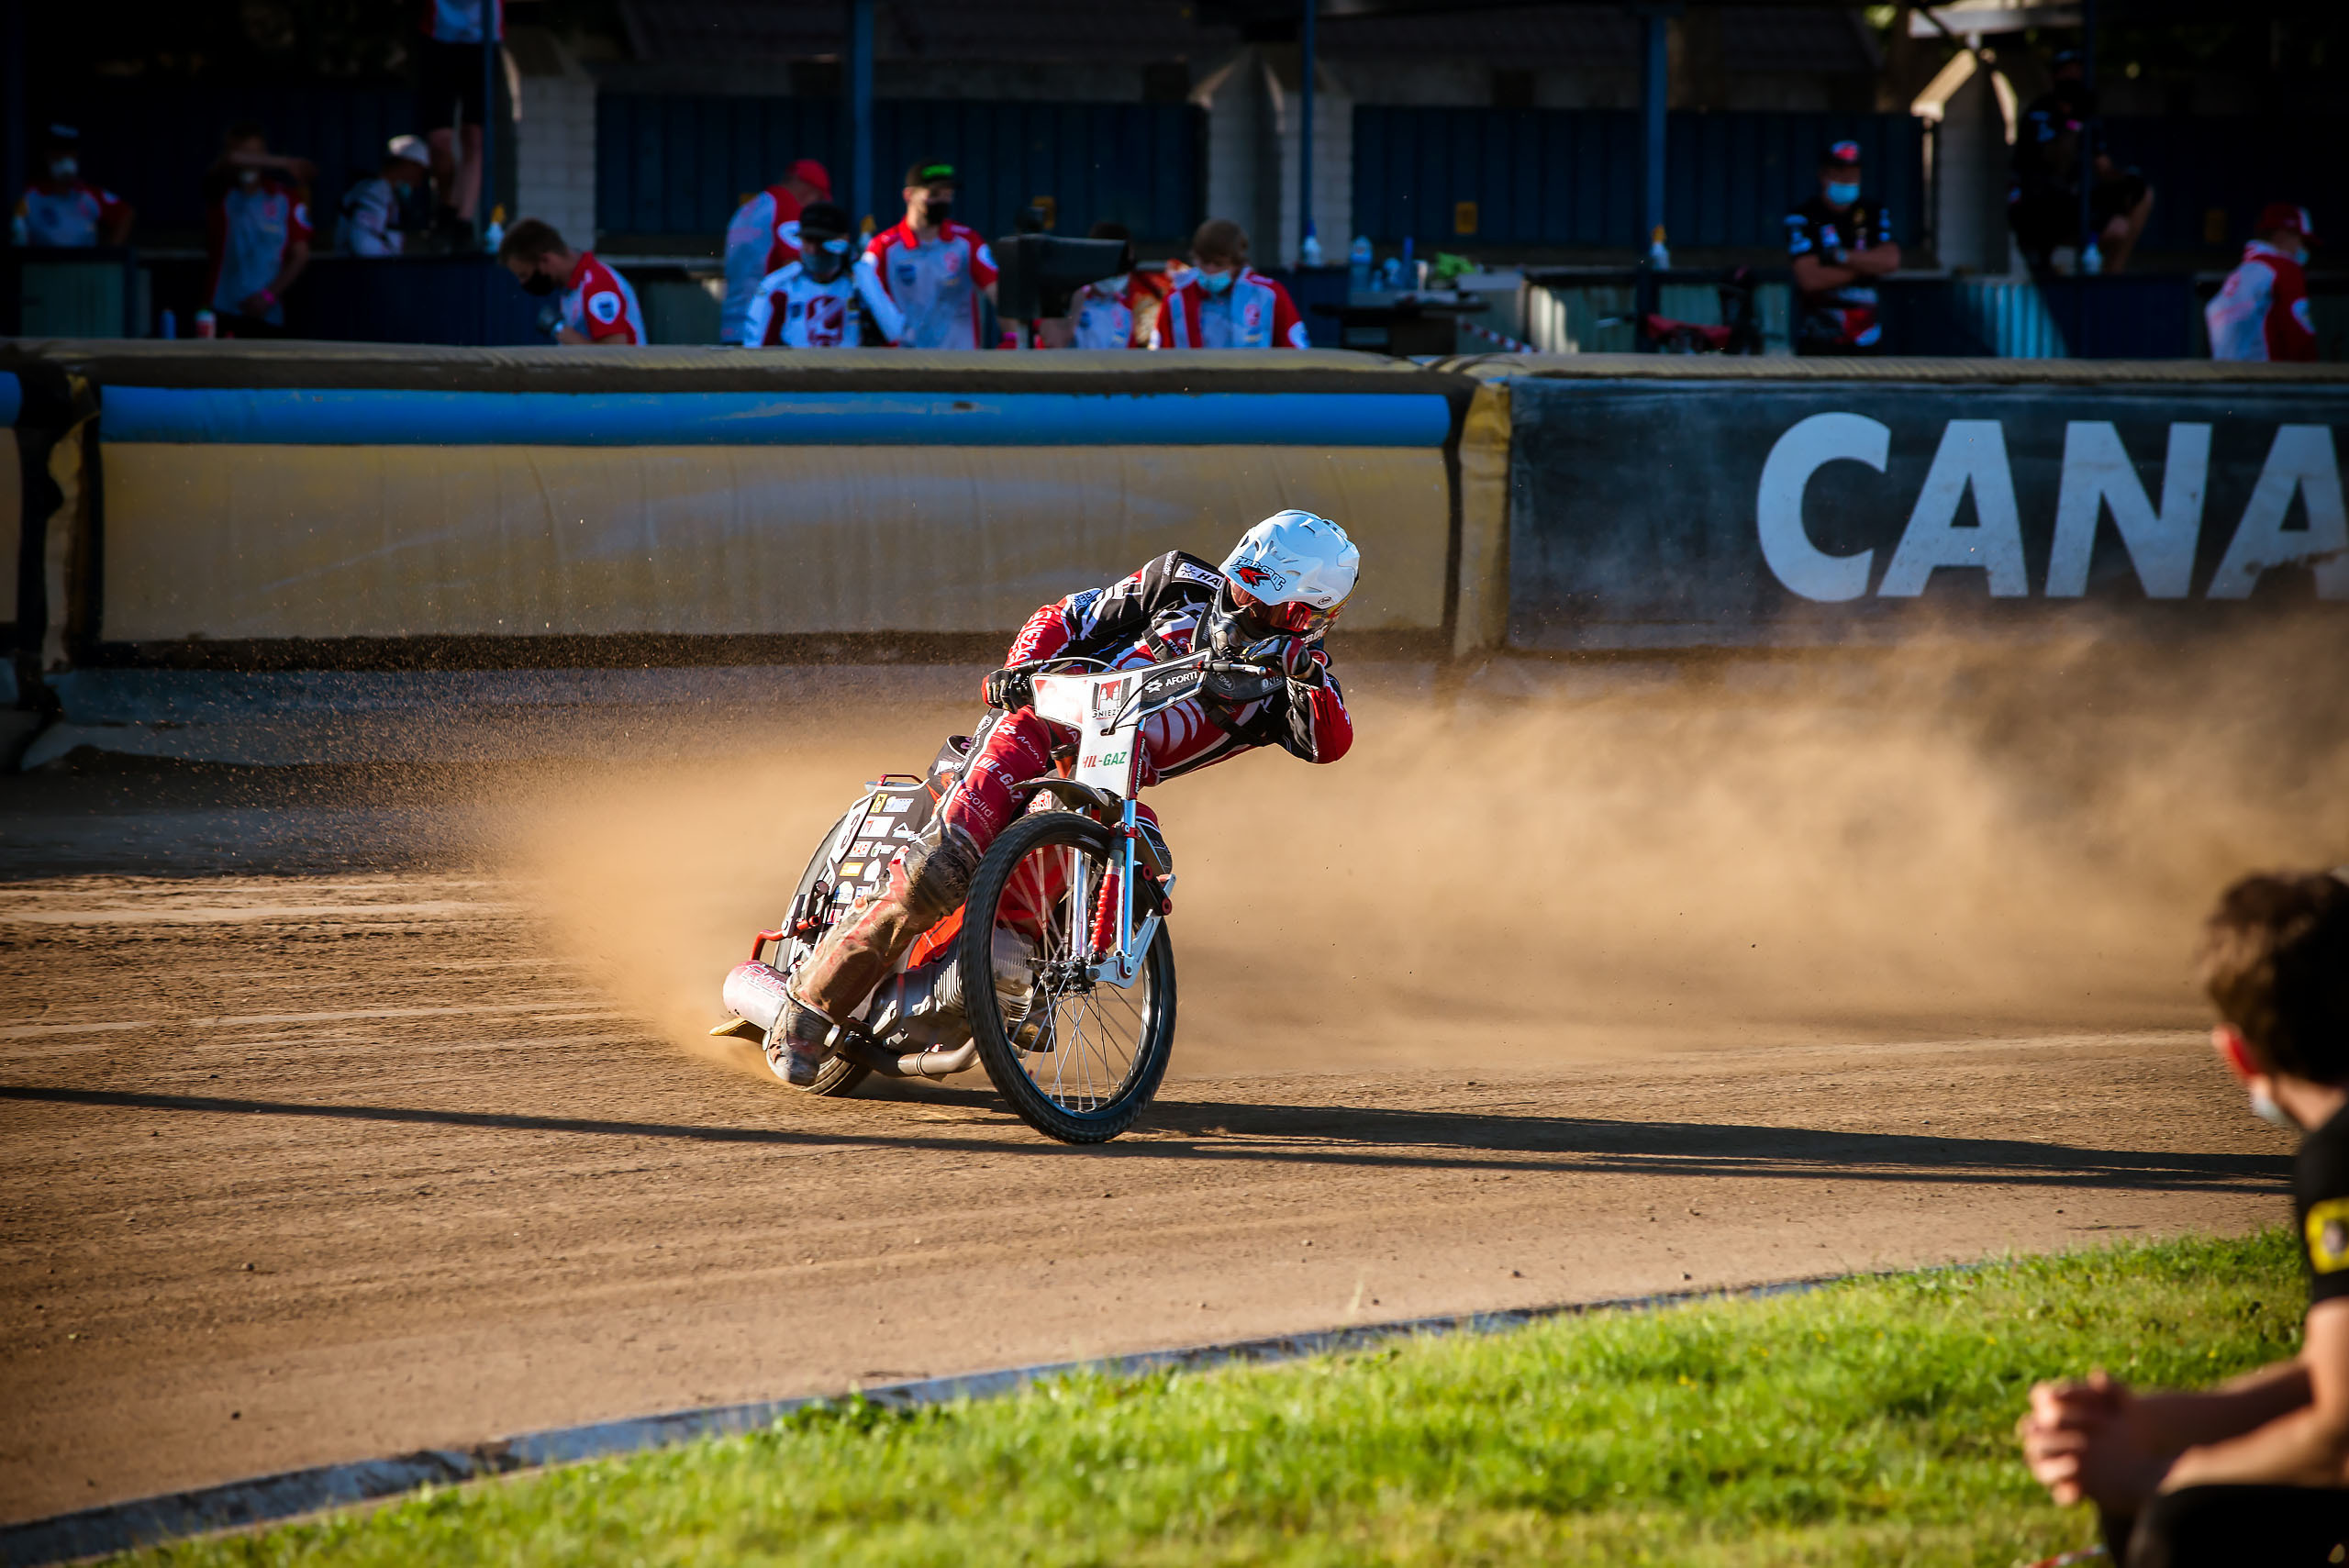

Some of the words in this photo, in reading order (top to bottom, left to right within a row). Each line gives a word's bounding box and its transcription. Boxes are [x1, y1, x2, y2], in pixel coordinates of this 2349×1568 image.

[1756, 411, 2349, 603] CANA
[1164, 672, 1199, 687] AFORTI
[1082, 751, 1128, 769] HIL-GAZ
